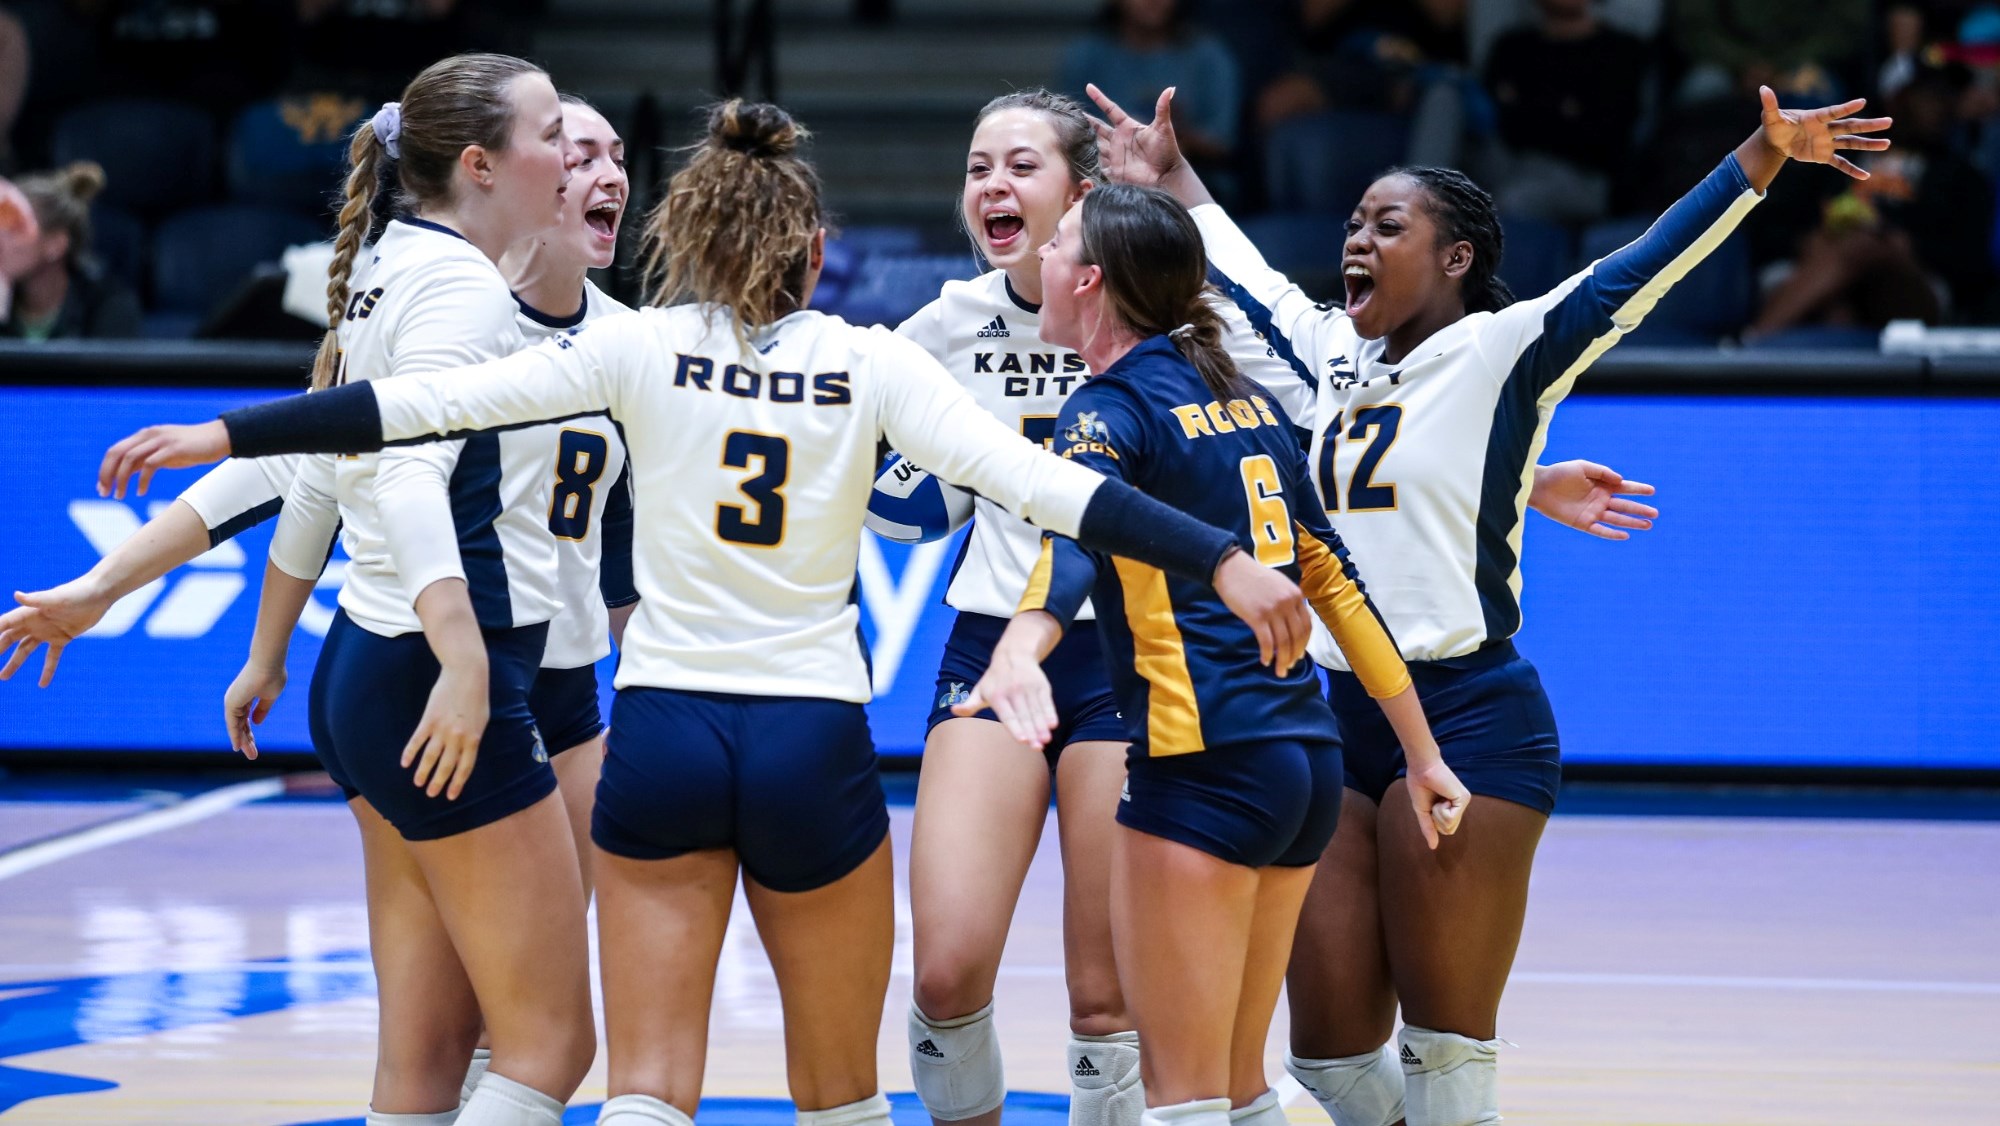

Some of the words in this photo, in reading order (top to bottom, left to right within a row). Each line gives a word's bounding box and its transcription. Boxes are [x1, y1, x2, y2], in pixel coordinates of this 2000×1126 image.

[976, 329, 1010, 338] adidas
[673, 353, 852, 405] ROOS
[974, 352, 1086, 374] KANS
[1319, 402, 1405, 514] 12
[547, 427, 609, 542] 8
[713, 428, 792, 549] 3
[1240, 454, 1295, 567] 6
[916, 1045, 944, 1057] adidas
[1075, 1068, 1100, 1076] adidas
